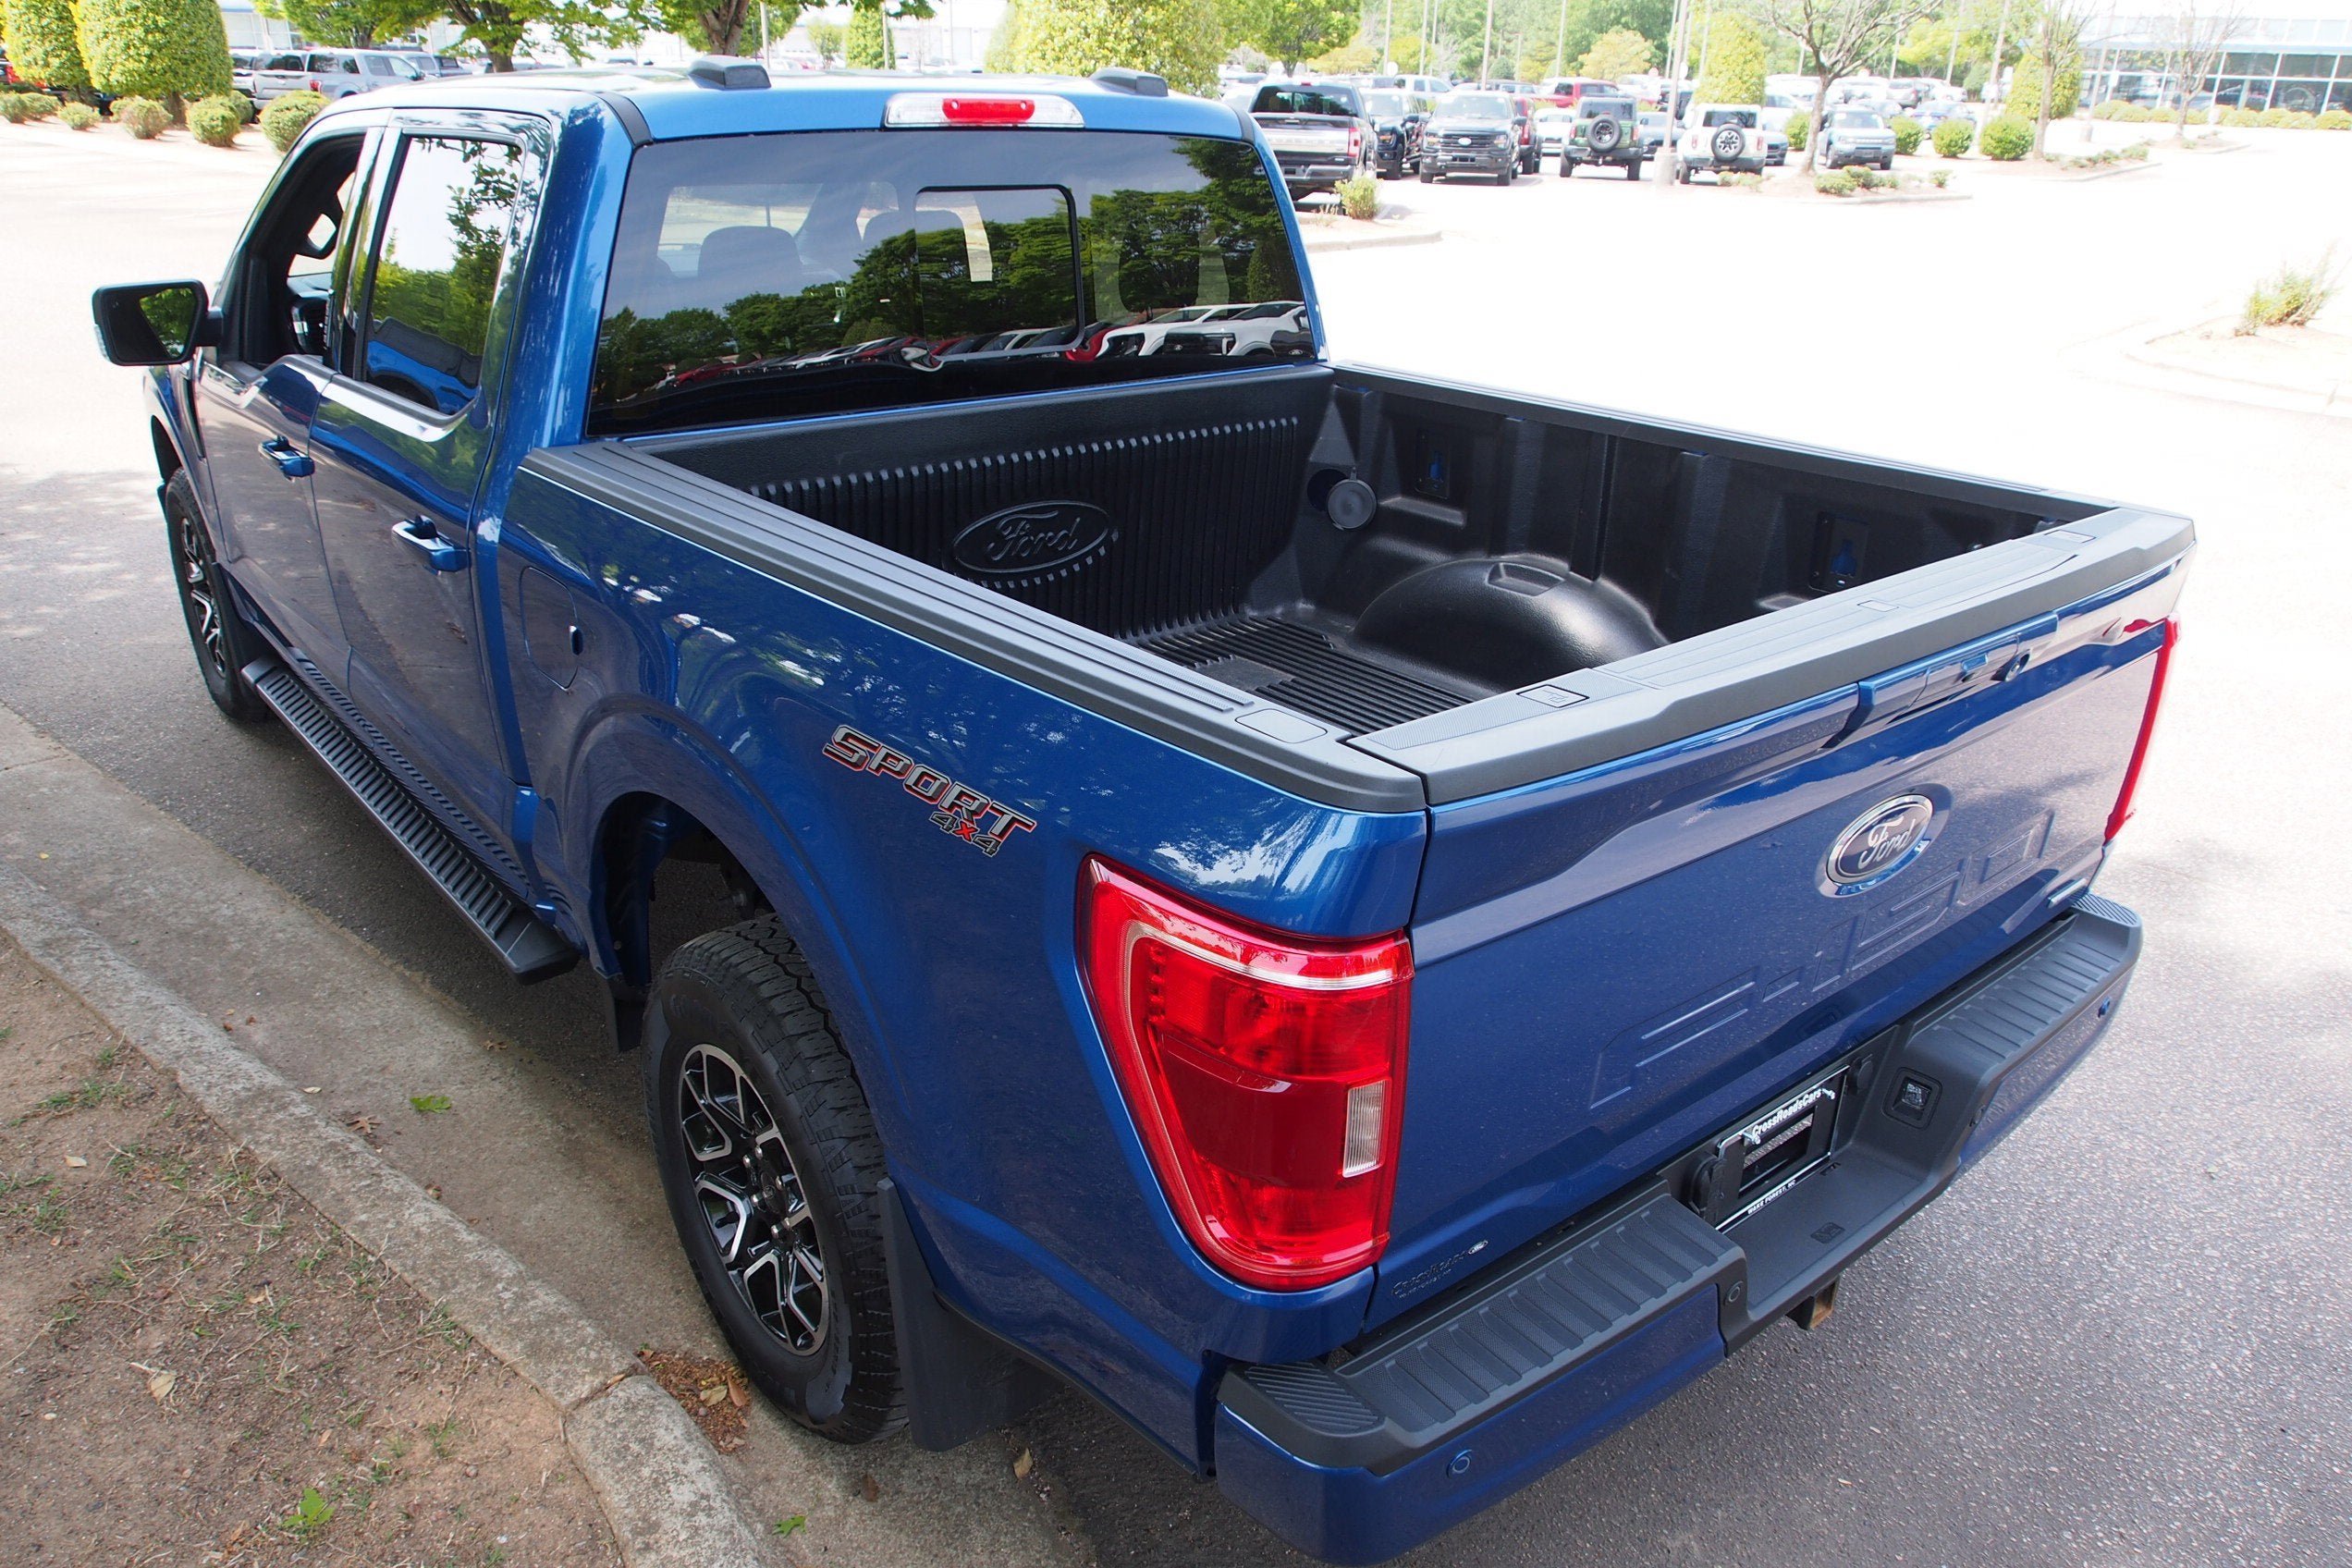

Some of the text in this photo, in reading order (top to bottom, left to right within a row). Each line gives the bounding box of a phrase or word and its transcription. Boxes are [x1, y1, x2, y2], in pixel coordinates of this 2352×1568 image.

[986, 509, 1081, 561] Ford
[822, 724, 1037, 841] SPORT
[1856, 815, 1917, 870] Ford
